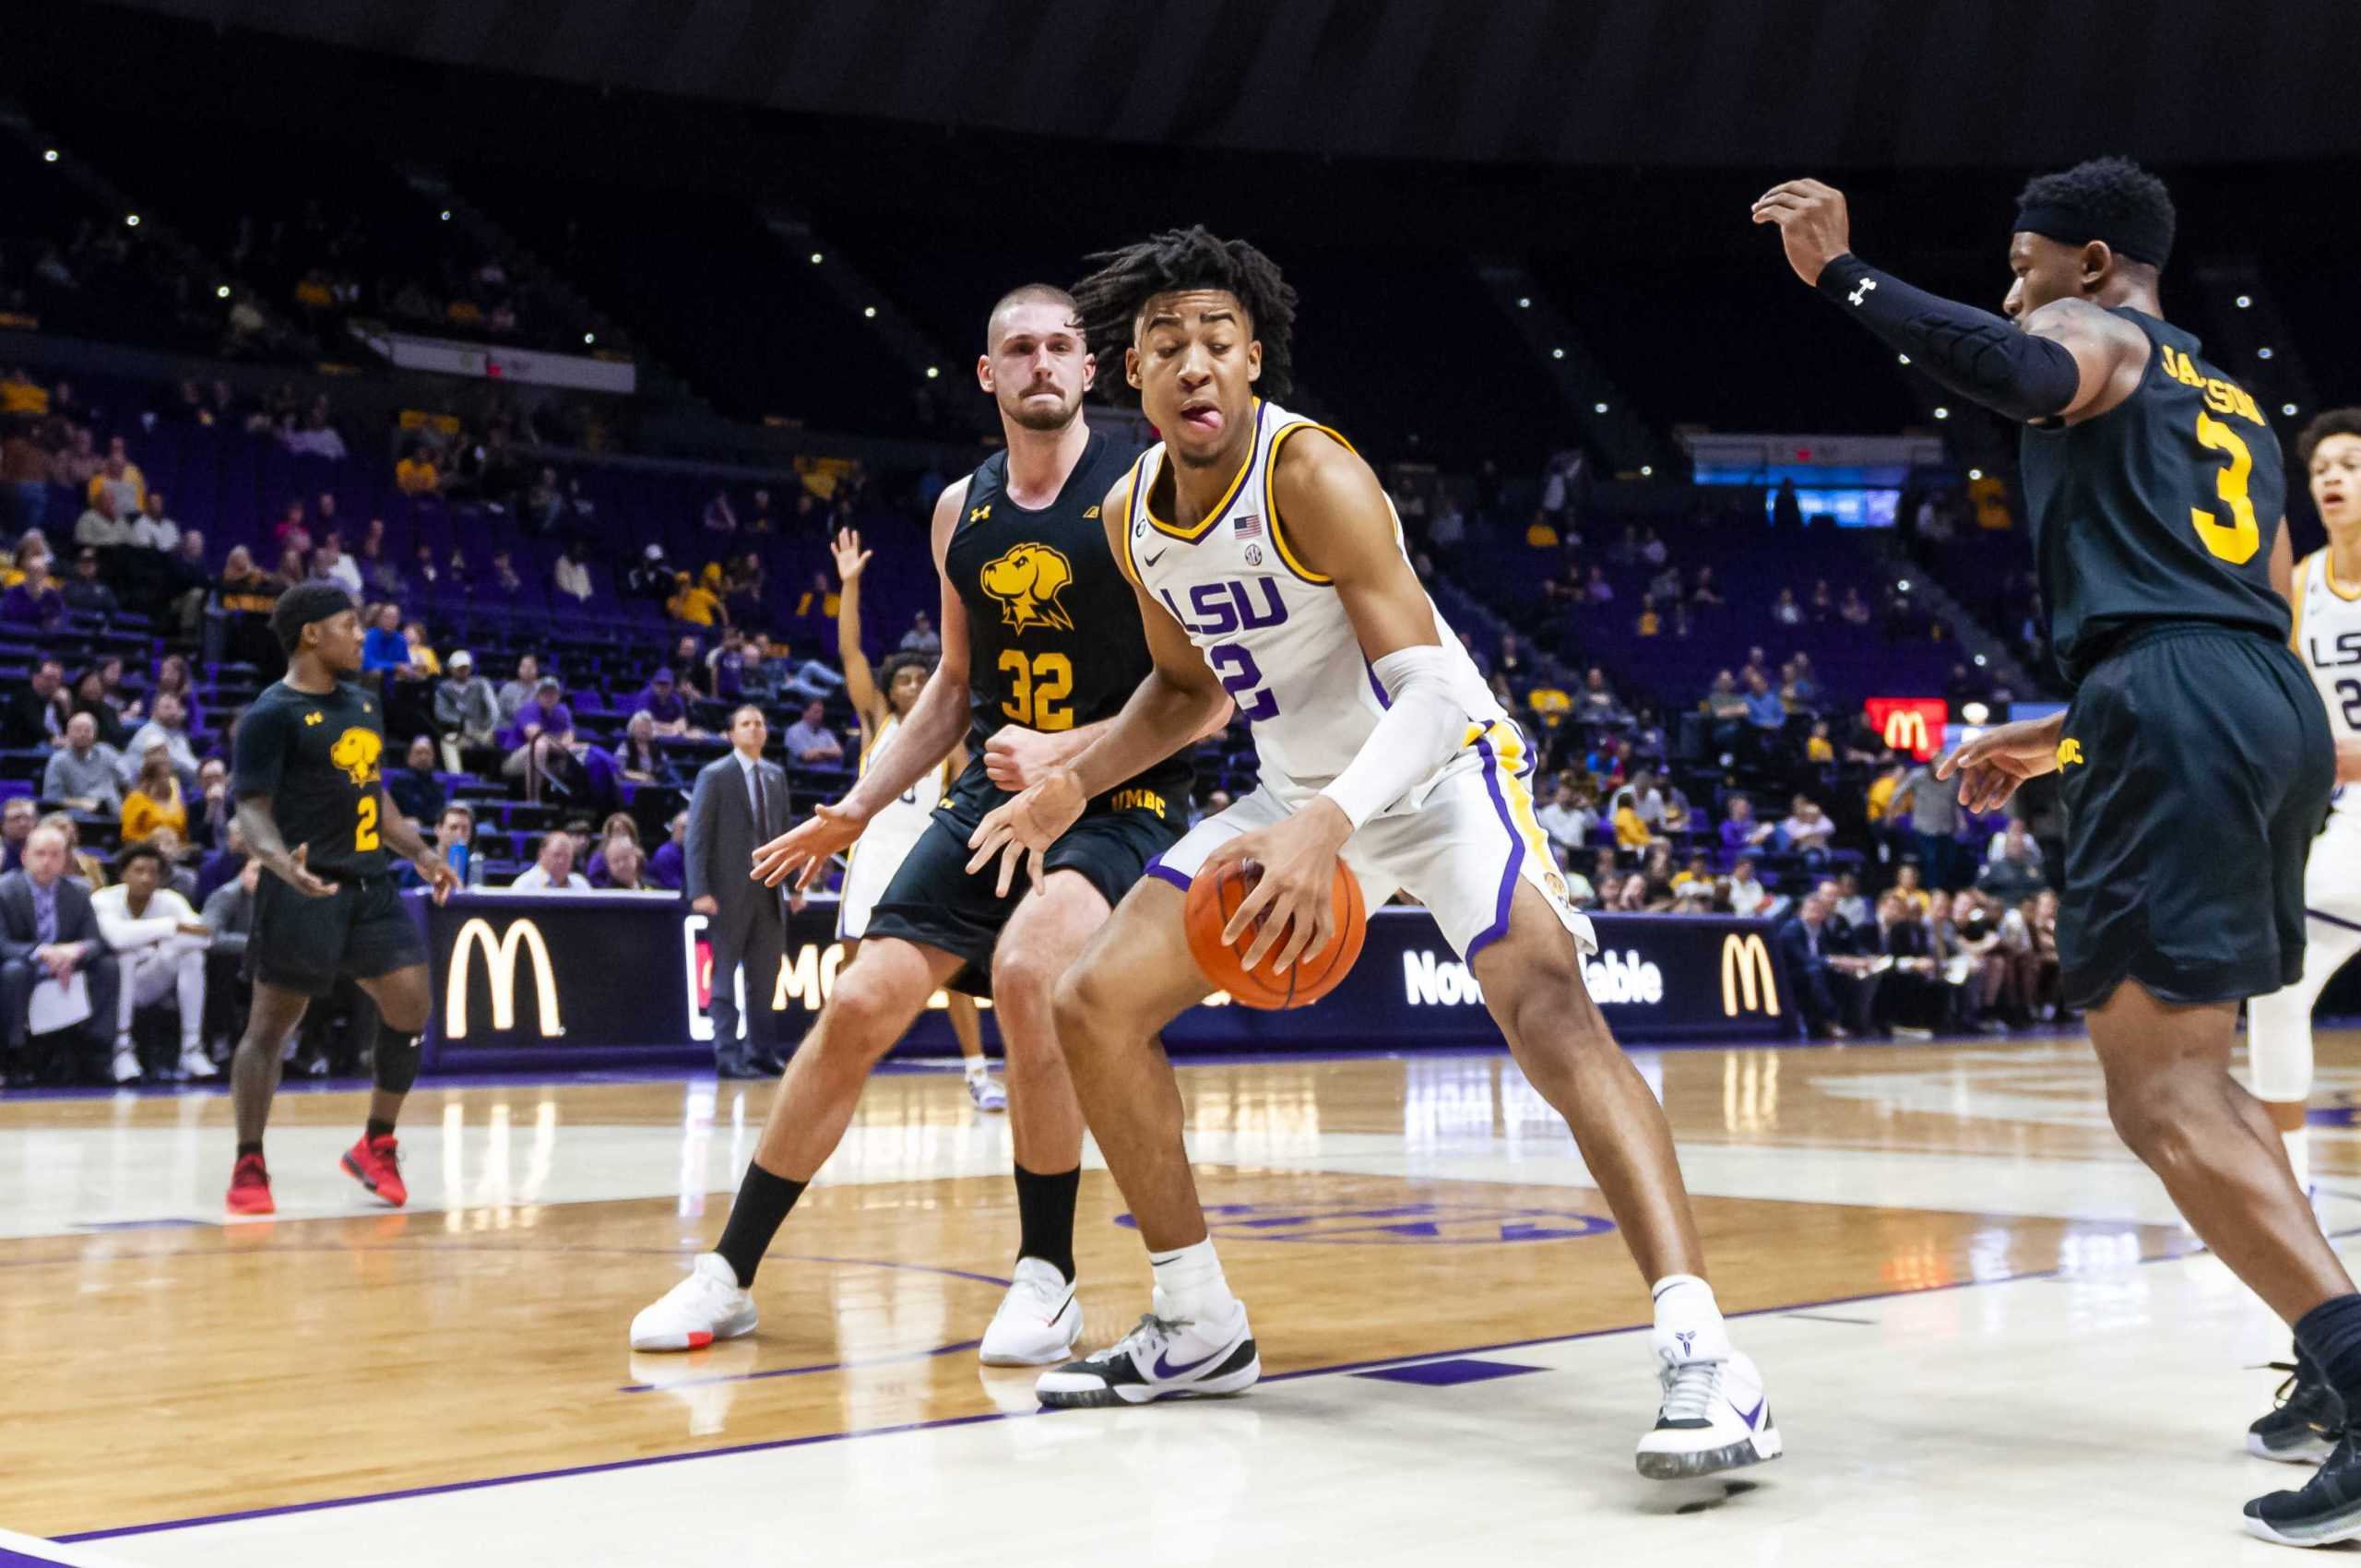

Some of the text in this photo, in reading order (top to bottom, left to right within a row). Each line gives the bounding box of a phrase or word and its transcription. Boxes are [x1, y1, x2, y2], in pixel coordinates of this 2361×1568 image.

[2190, 410, 2260, 565] 3
[1160, 576, 1289, 636] LSU
[1210, 643, 1281, 722] 2
[2309, 632, 2361, 668] LS
[998, 648, 1074, 731] 32
[355, 795, 381, 852] 2
